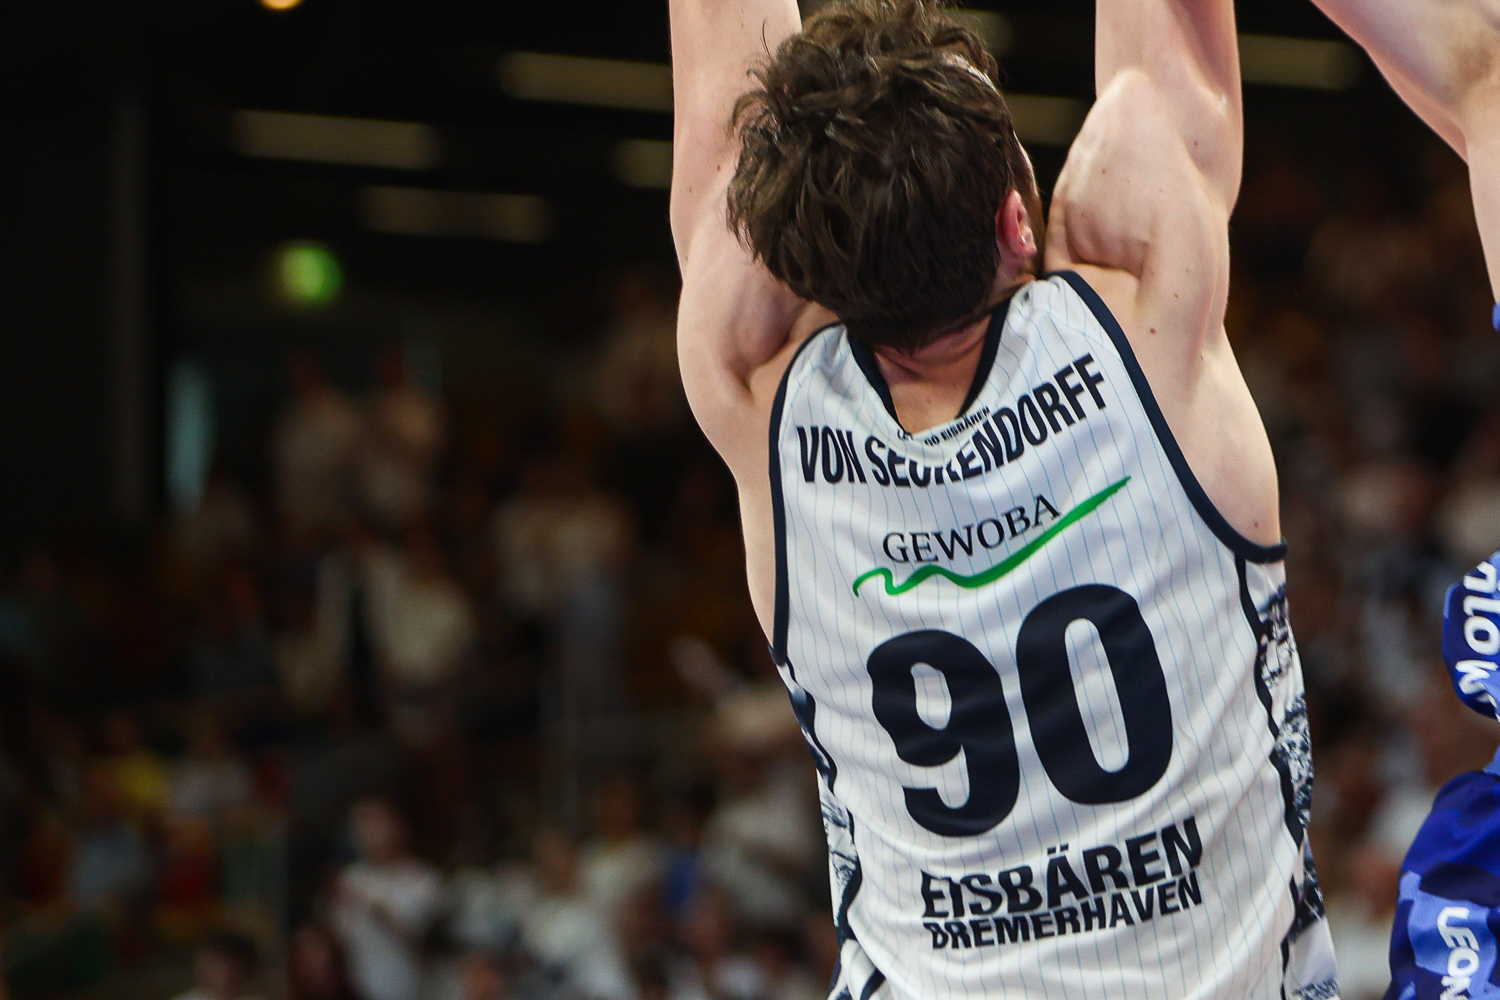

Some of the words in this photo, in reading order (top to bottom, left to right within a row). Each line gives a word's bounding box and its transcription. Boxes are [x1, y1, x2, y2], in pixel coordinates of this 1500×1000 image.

[796, 425, 866, 483] VON
[882, 494, 1060, 563] GEWOBA
[866, 583, 1173, 837] 90
[920, 816, 1204, 919] EISBÄREN
[930, 873, 1203, 950] BREMERHAVEN
